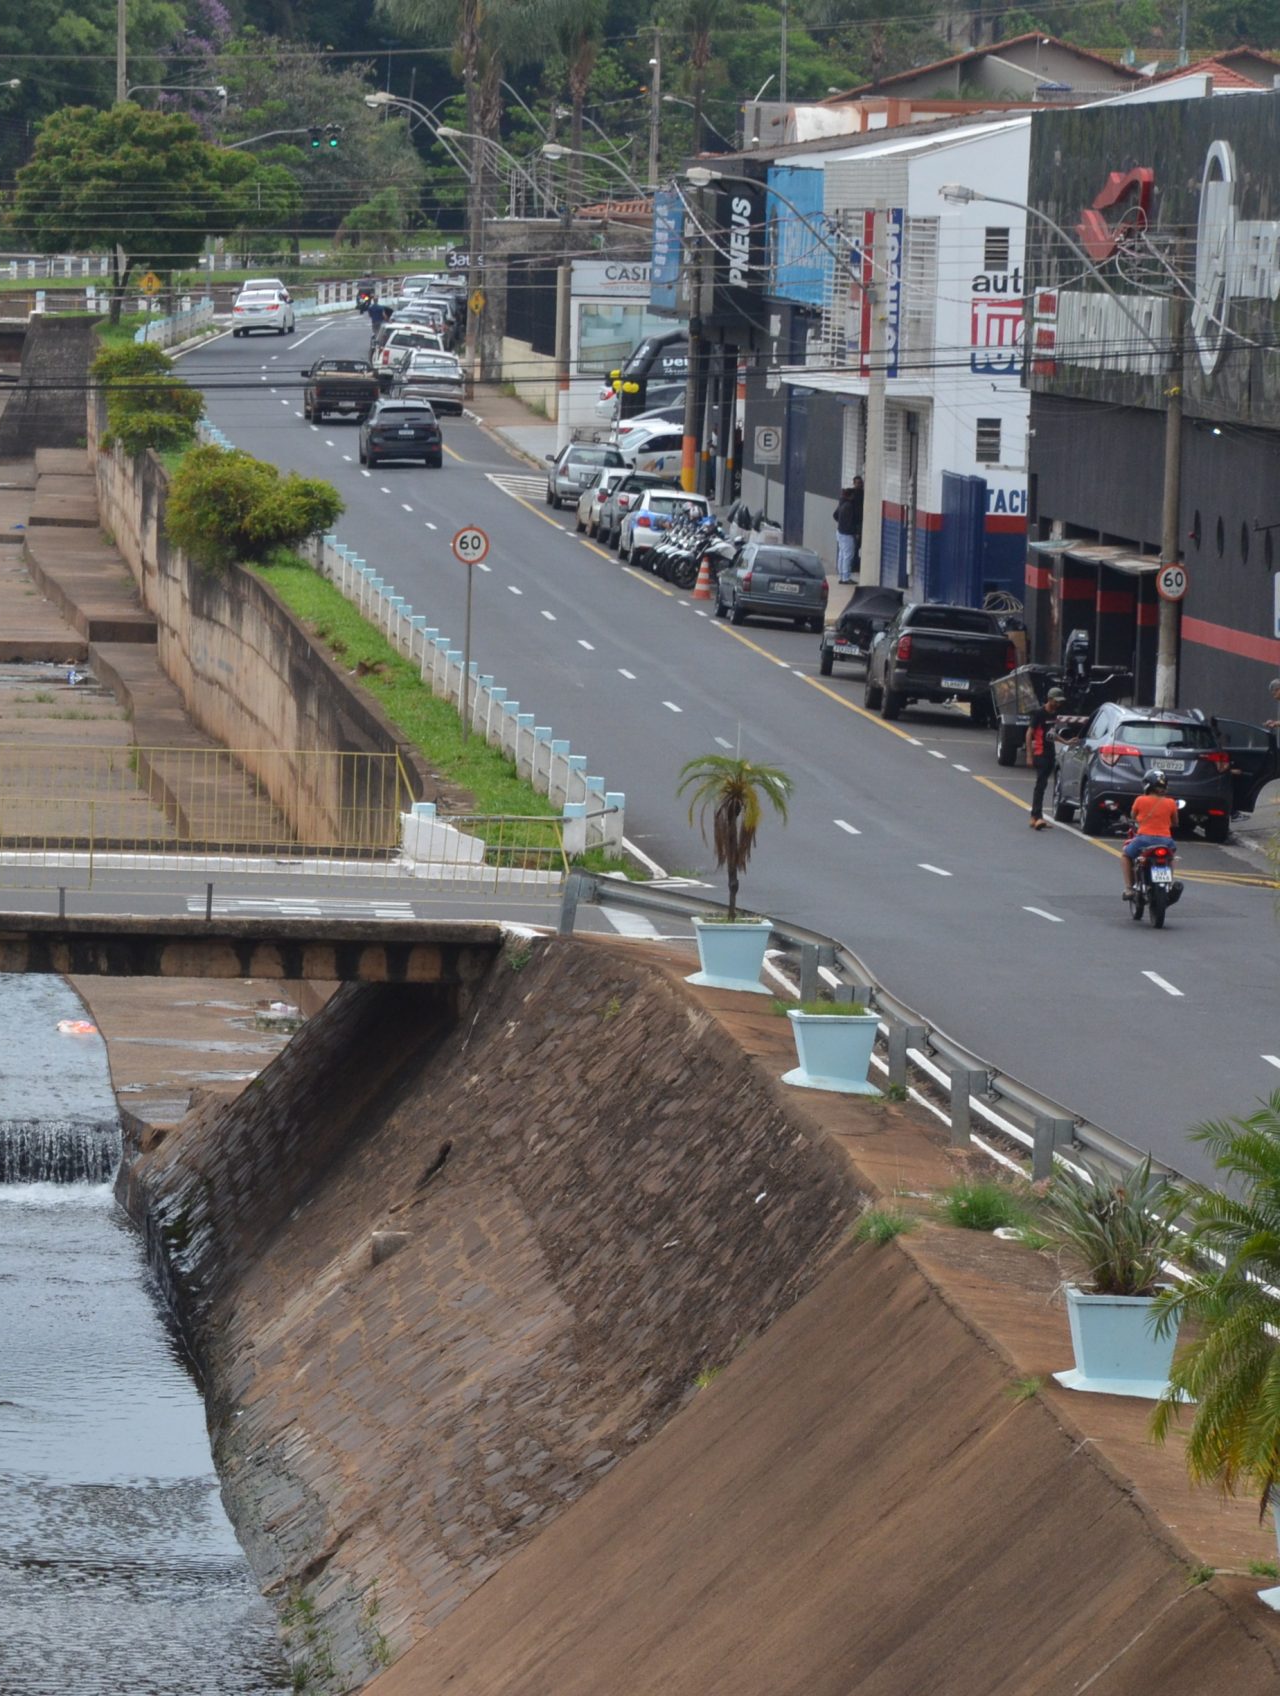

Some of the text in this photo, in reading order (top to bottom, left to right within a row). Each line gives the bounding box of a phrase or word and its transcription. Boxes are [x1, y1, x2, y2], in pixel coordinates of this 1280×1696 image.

[729, 197, 752, 289] PNEUS
[605, 265, 651, 281] CASI
[763, 432, 773, 447] E
[459, 534, 481, 550] 60
[1163, 571, 1184, 588] 60
